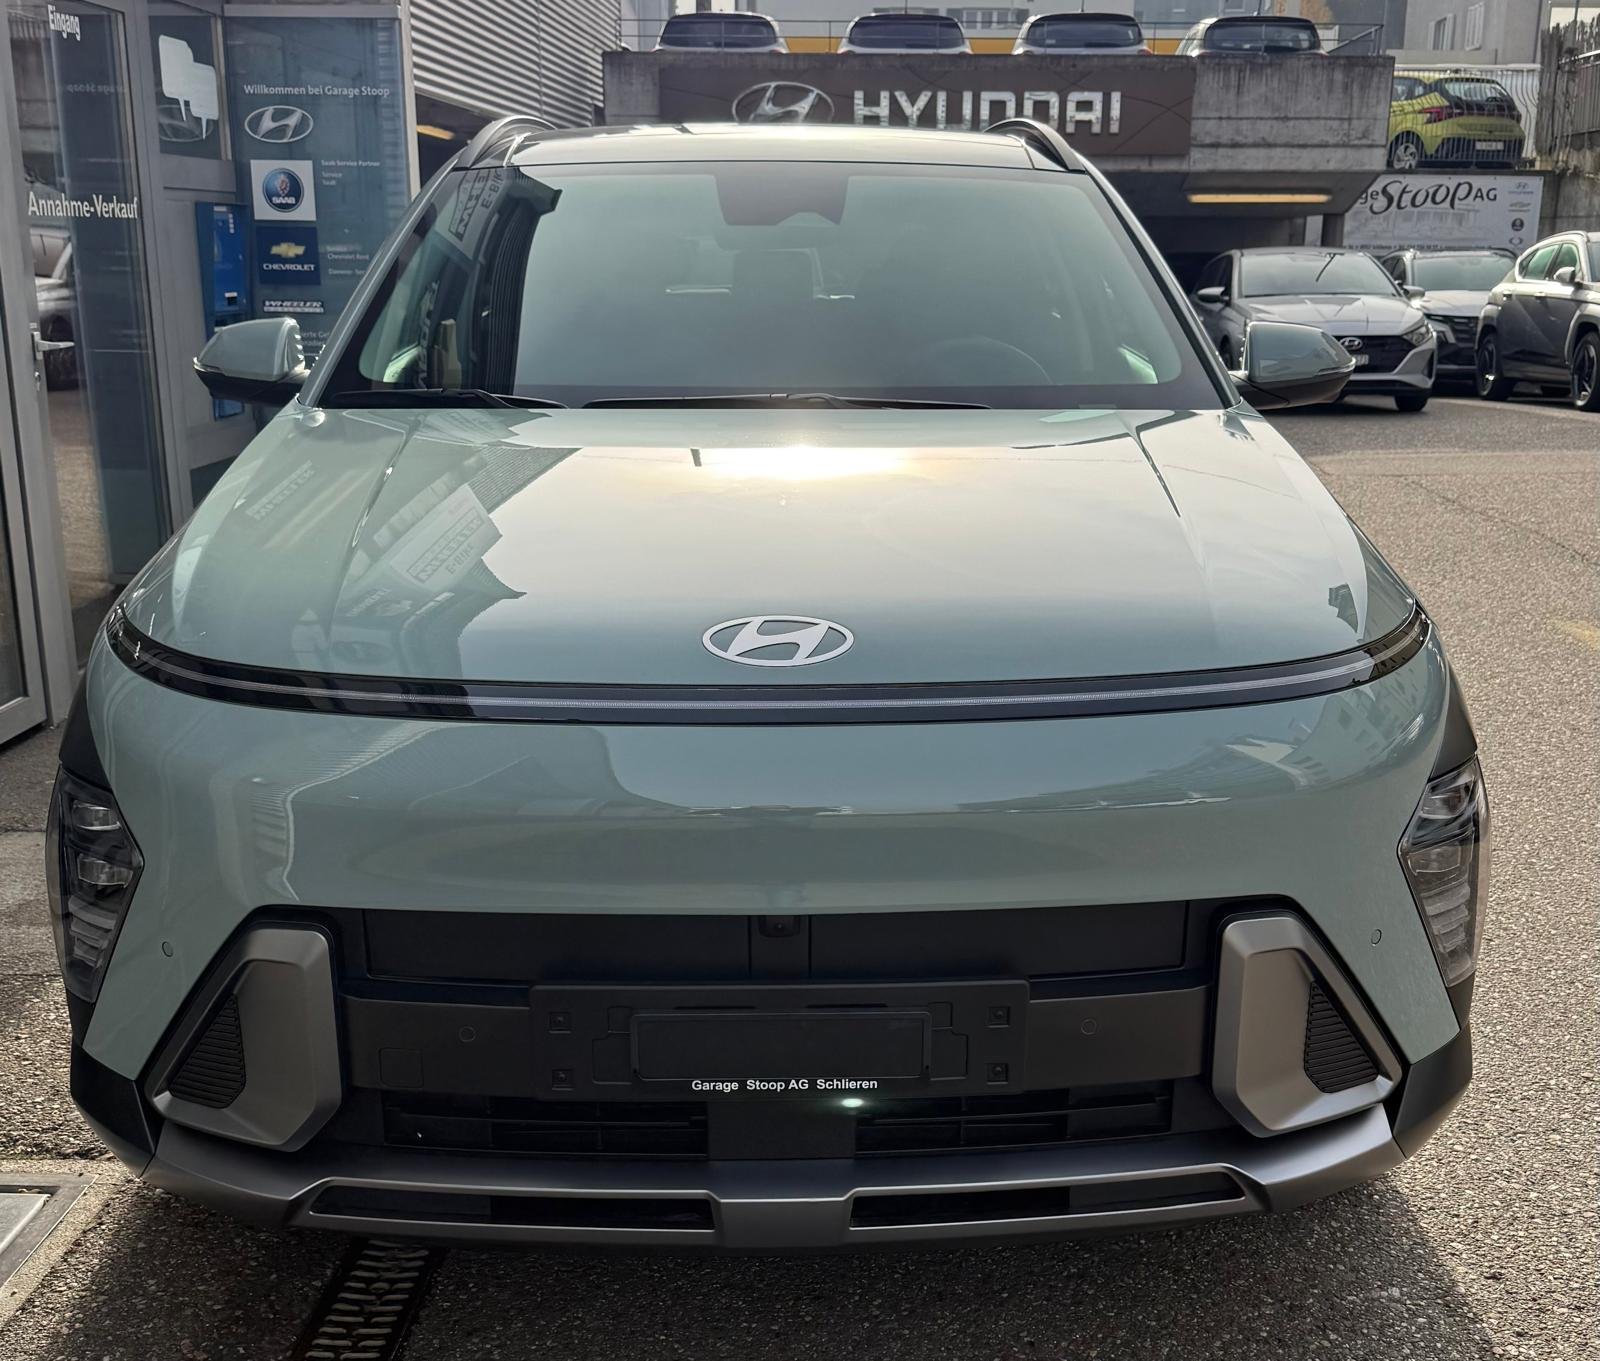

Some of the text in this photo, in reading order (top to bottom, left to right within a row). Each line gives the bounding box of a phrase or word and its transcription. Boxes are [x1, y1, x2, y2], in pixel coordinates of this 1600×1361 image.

[48, 4, 81, 41] Eingang
[243, 84, 390, 98] Willkommen bei Garage Stoop
[853, 89, 1121, 135] HYUNDAI
[28, 191, 138, 219] Annahme-Verkauf
[272, 196, 296, 204] SAAB
[1369, 180, 1473, 215] Stoop
[1472, 187, 1498, 202] AG
[263, 263, 315, 271] CHEVROLET
[691, 1078, 878, 1093] Garage Stoop AG Schlieren
